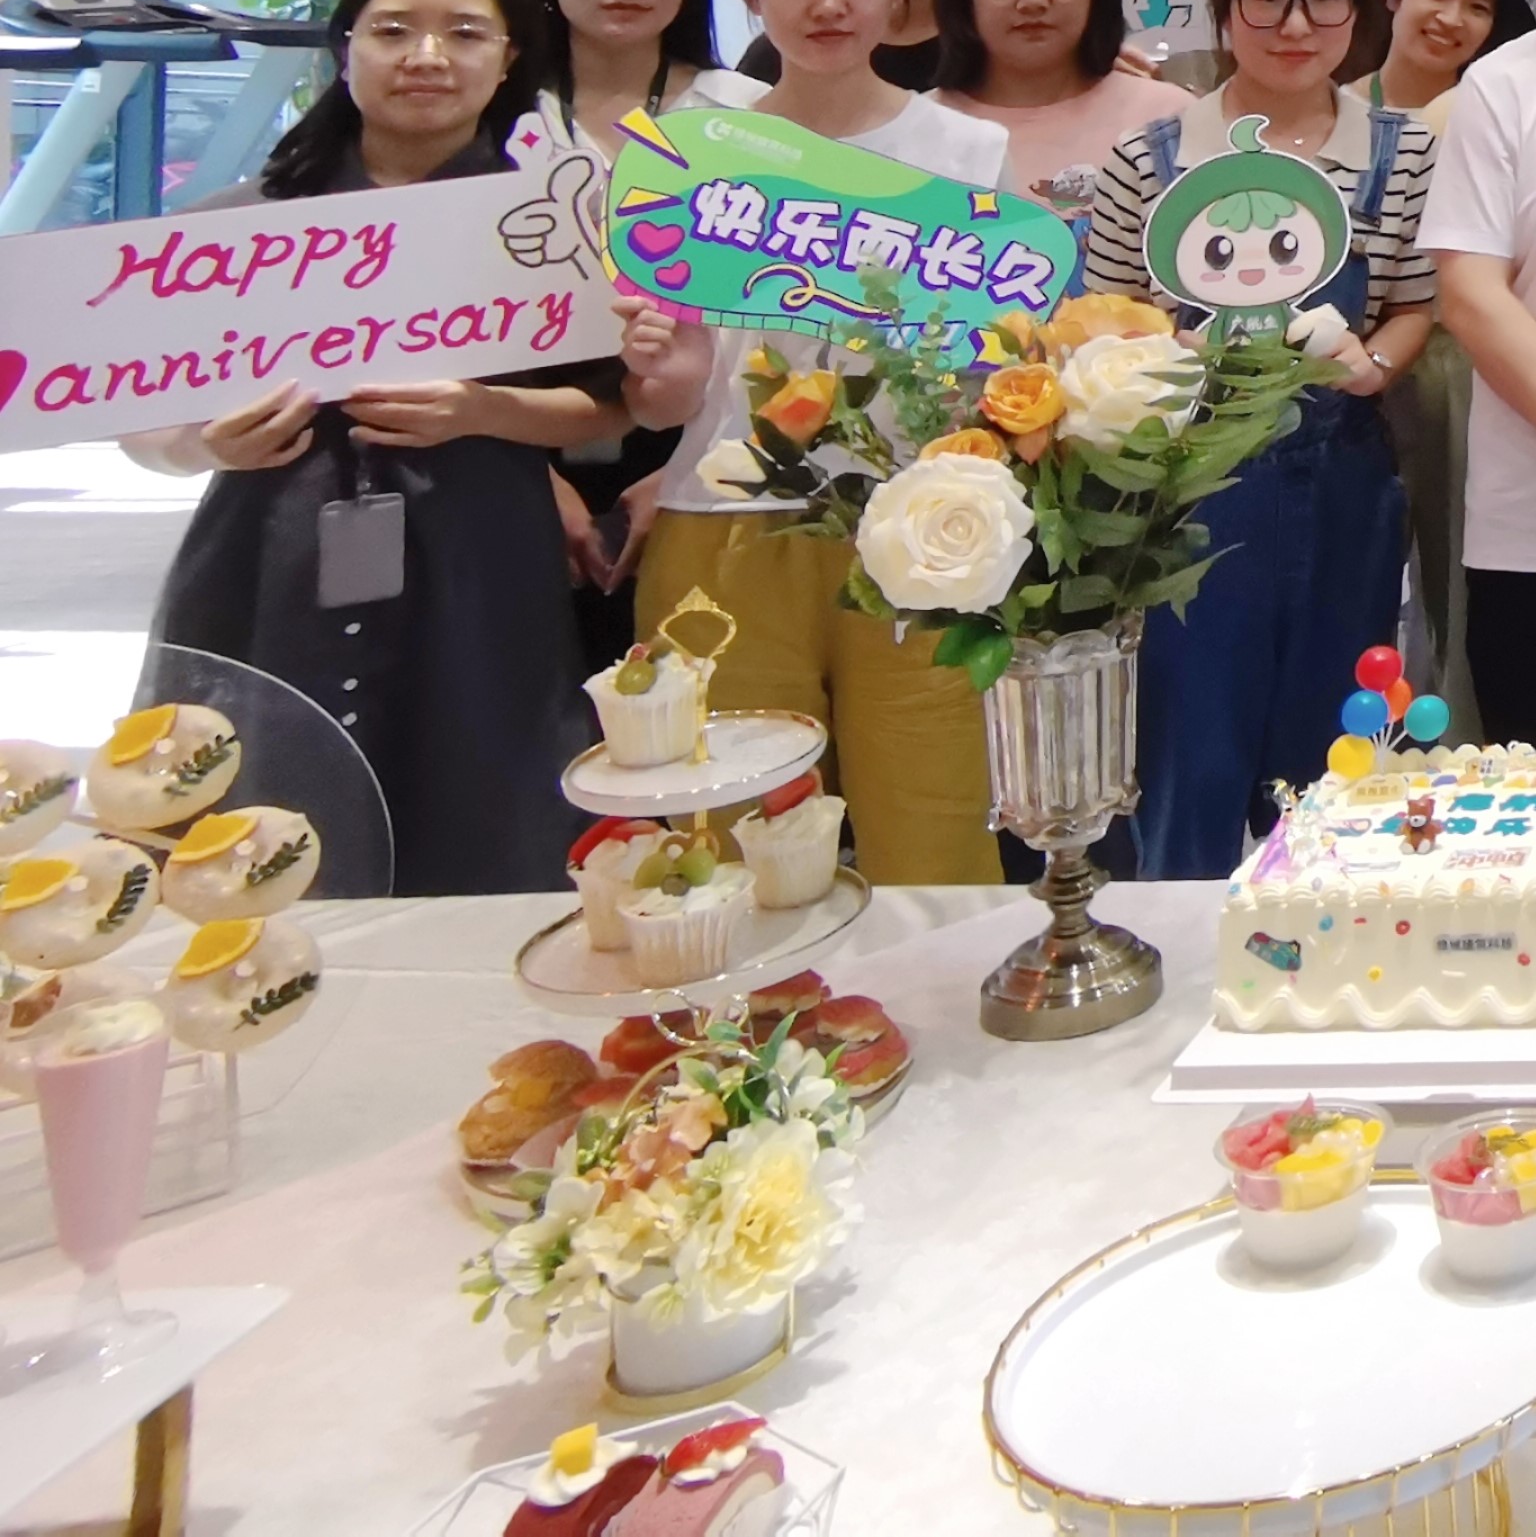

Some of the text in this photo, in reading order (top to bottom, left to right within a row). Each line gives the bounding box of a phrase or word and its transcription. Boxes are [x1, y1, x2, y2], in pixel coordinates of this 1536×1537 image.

[86, 221, 398, 307] Happy
[690, 178, 1056, 312] 快乐而长久
[33, 290, 575, 413] anniversary
